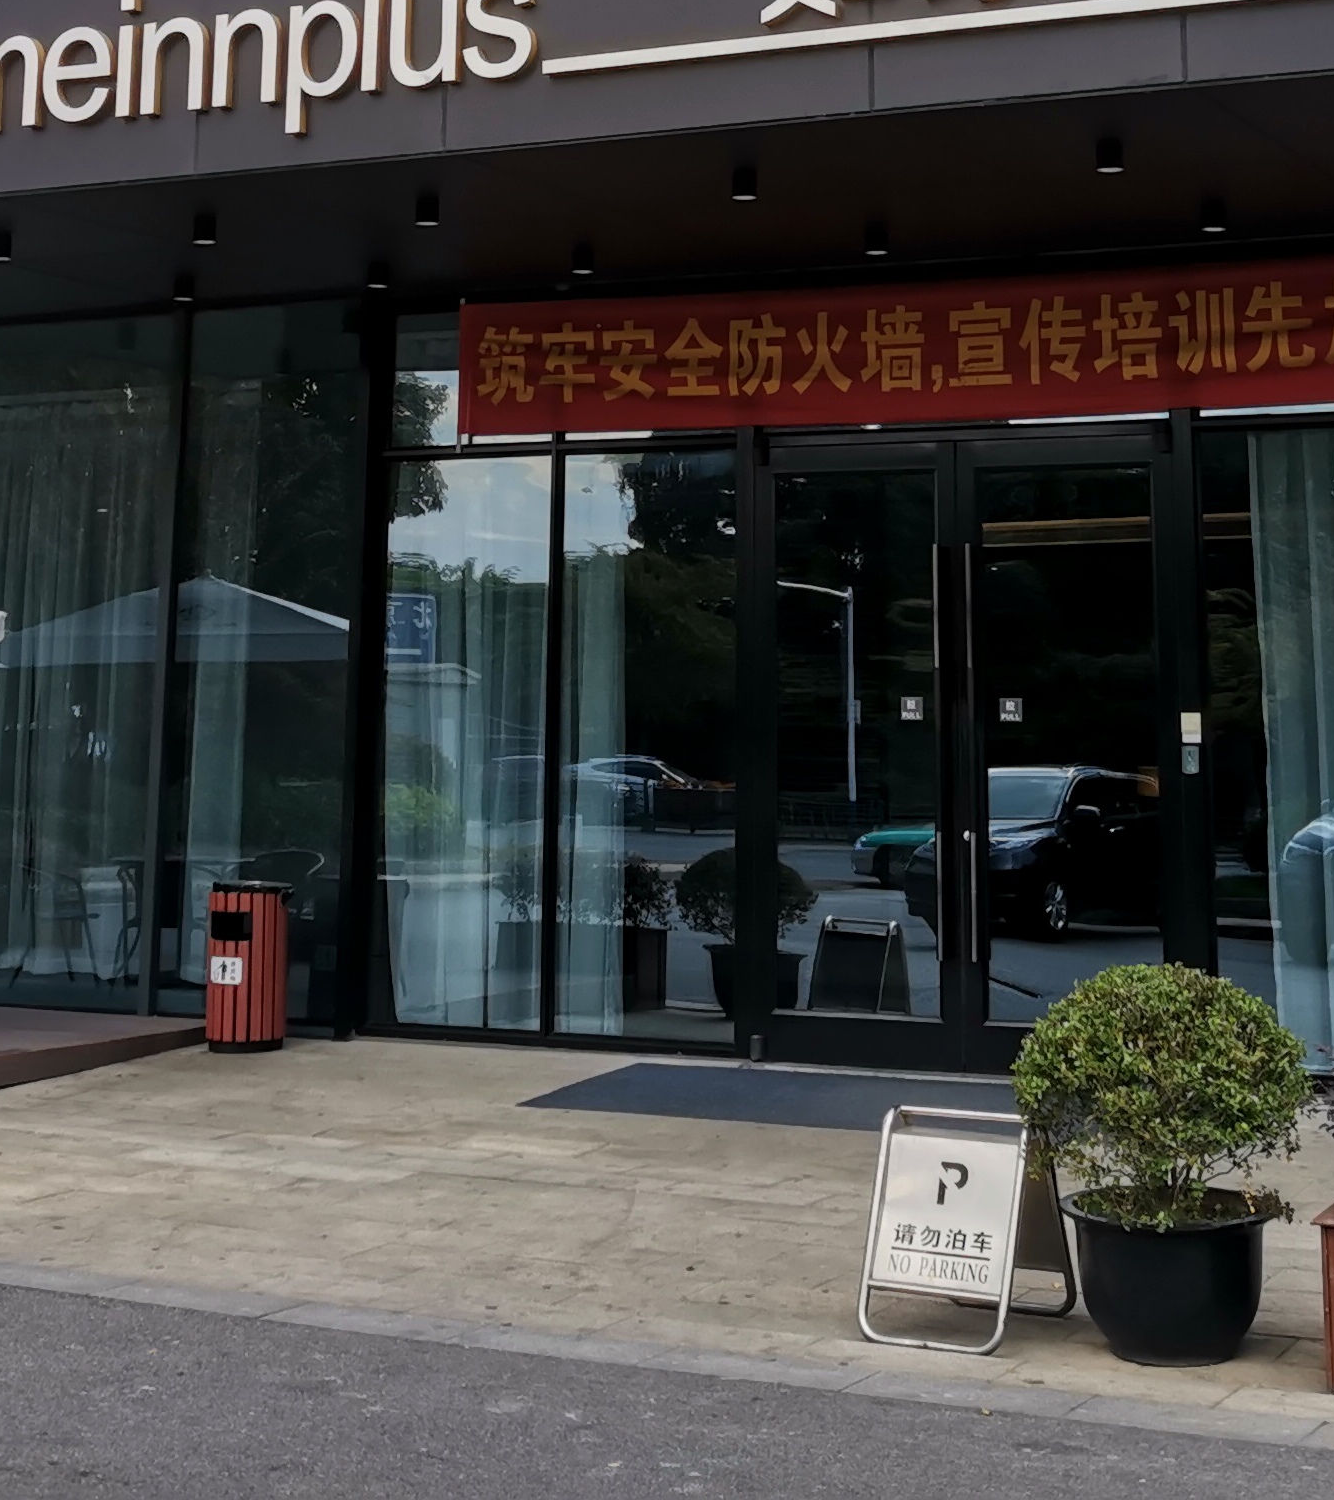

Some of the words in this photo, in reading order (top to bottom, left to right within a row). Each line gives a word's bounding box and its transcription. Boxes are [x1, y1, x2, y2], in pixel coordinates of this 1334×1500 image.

[893, 1222, 993, 1254] 请勿泊车
[887, 1253, 912, 1275] NO
[918, 1256, 990, 1285] PARKING
